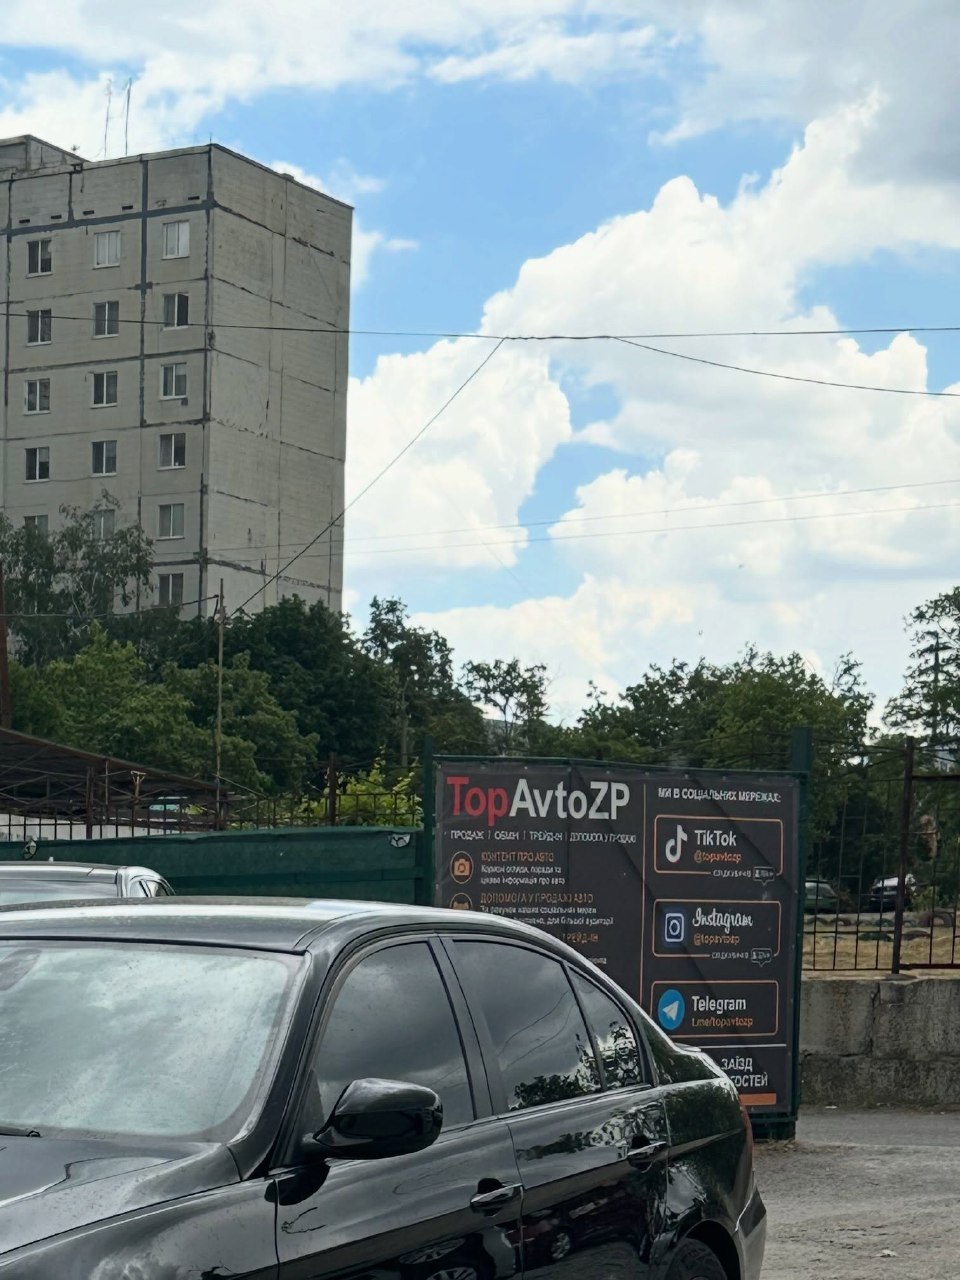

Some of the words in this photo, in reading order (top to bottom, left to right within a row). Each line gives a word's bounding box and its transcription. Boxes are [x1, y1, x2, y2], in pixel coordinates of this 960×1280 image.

[446, 776, 631, 827] TopAvtoZP
[673, 788, 680, 799] В
[694, 830, 737, 846] TikTok
[692, 908, 753, 934] Instagram
[692, 996, 747, 1014] Telegram
[721, 1056, 753, 1072] ЗАЇЗД
